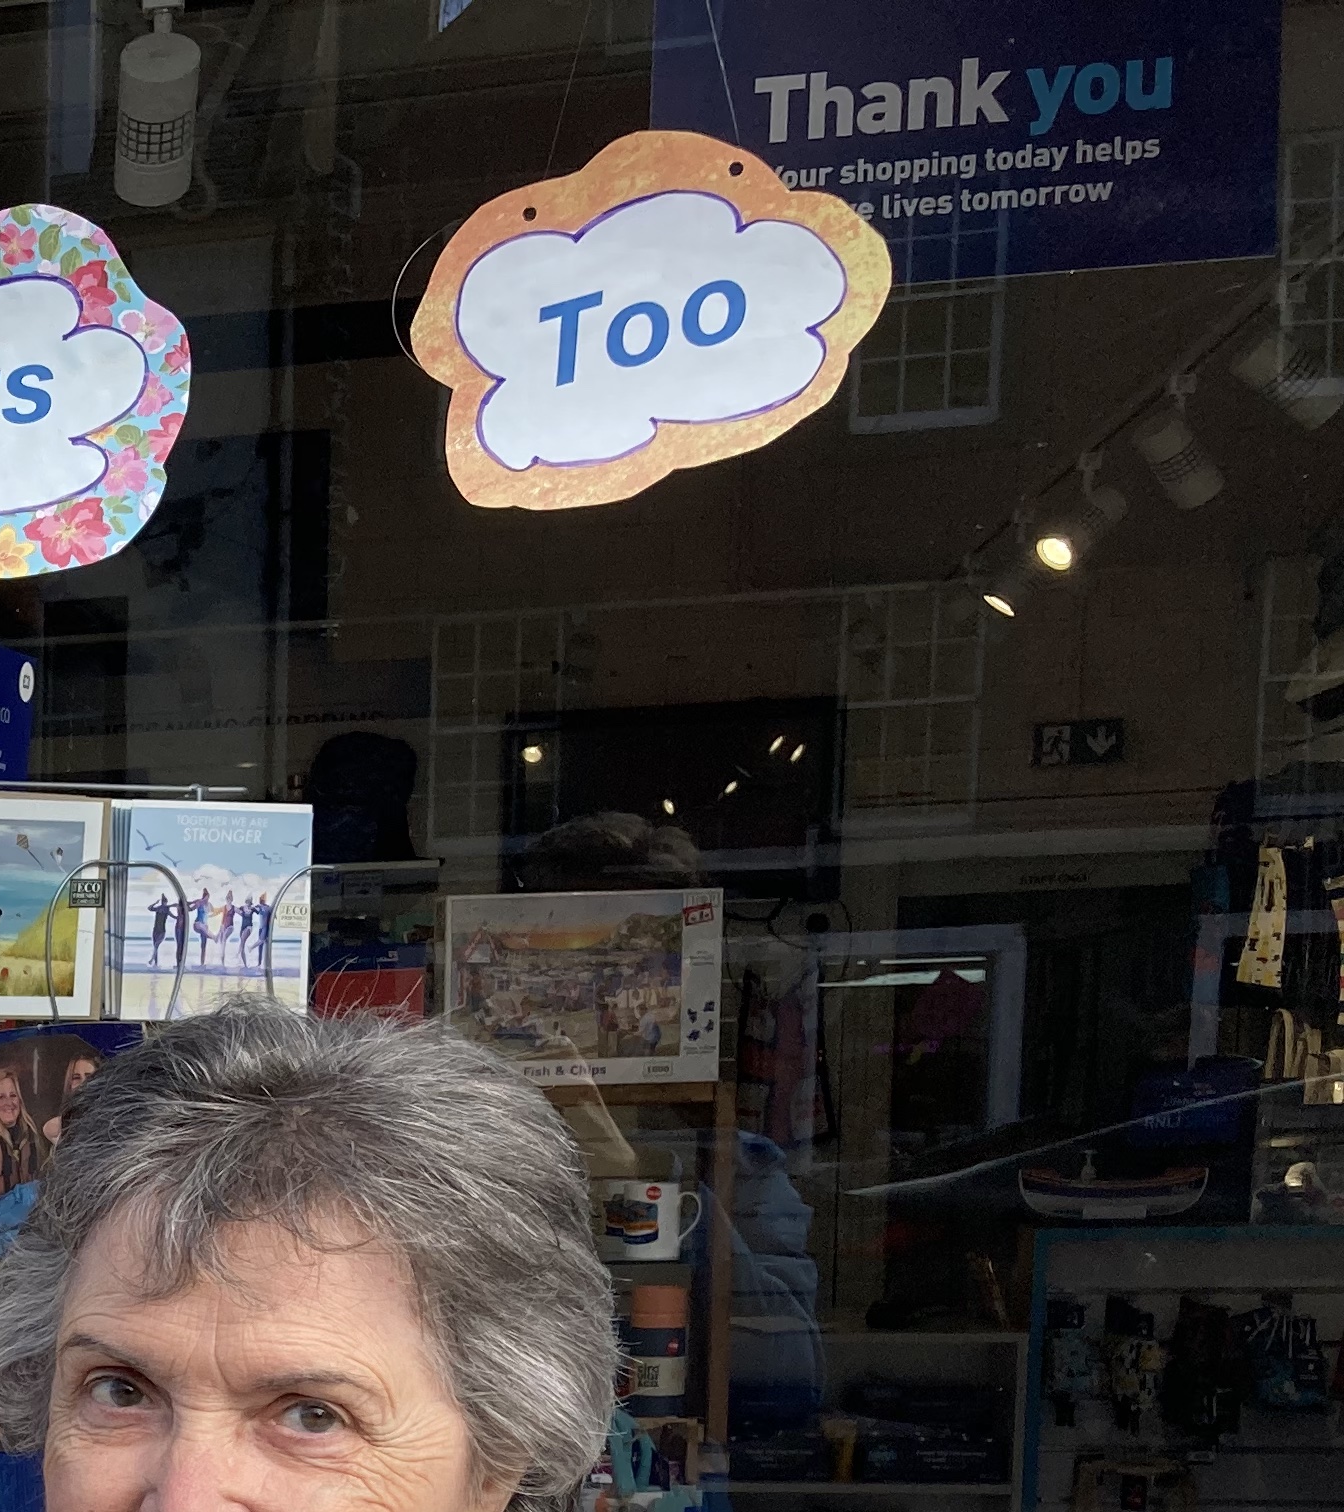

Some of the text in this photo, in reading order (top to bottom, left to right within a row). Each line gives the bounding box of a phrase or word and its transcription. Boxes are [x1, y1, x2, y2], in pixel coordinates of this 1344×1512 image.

[753, 55, 1175, 145] Thank you
[838, 151, 979, 189] shopping
[983, 141, 1071, 175] today
[1075, 136, 1163, 168] helps
[881, 180, 1116, 220] lives tomorrow
[537, 278, 749, 388] Too
[177, 814, 269, 828] TOGETHER WE ARE
[183, 827, 263, 844] STRONGER
[77, 882, 101, 893] ECO
[285, 904, 308, 916] ECO
[522, 1064, 607, 1080] Fish & Chips
